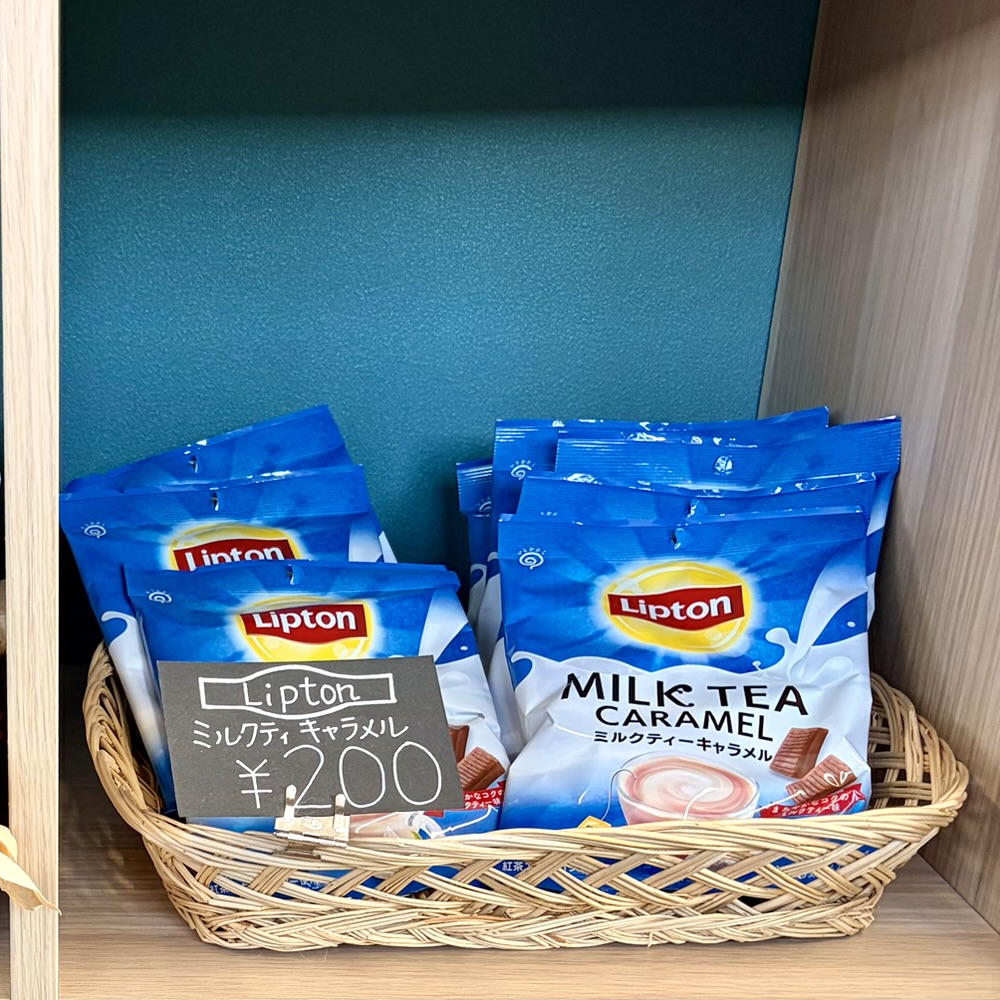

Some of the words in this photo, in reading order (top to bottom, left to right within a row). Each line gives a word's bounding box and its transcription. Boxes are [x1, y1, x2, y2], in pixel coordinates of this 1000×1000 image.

[253, 611, 356, 634] Lipton
[620, 596, 731, 621] Lipton
[242, 676, 361, 713] Lipton
[560, 672, 695, 708] MILK
[707, 685, 809, 716] TEA
[595, 705, 773, 742] CARAMEL
[593, 730, 773, 762] ミルクティーキャラメル
[235, 740, 442, 809] ¥200
